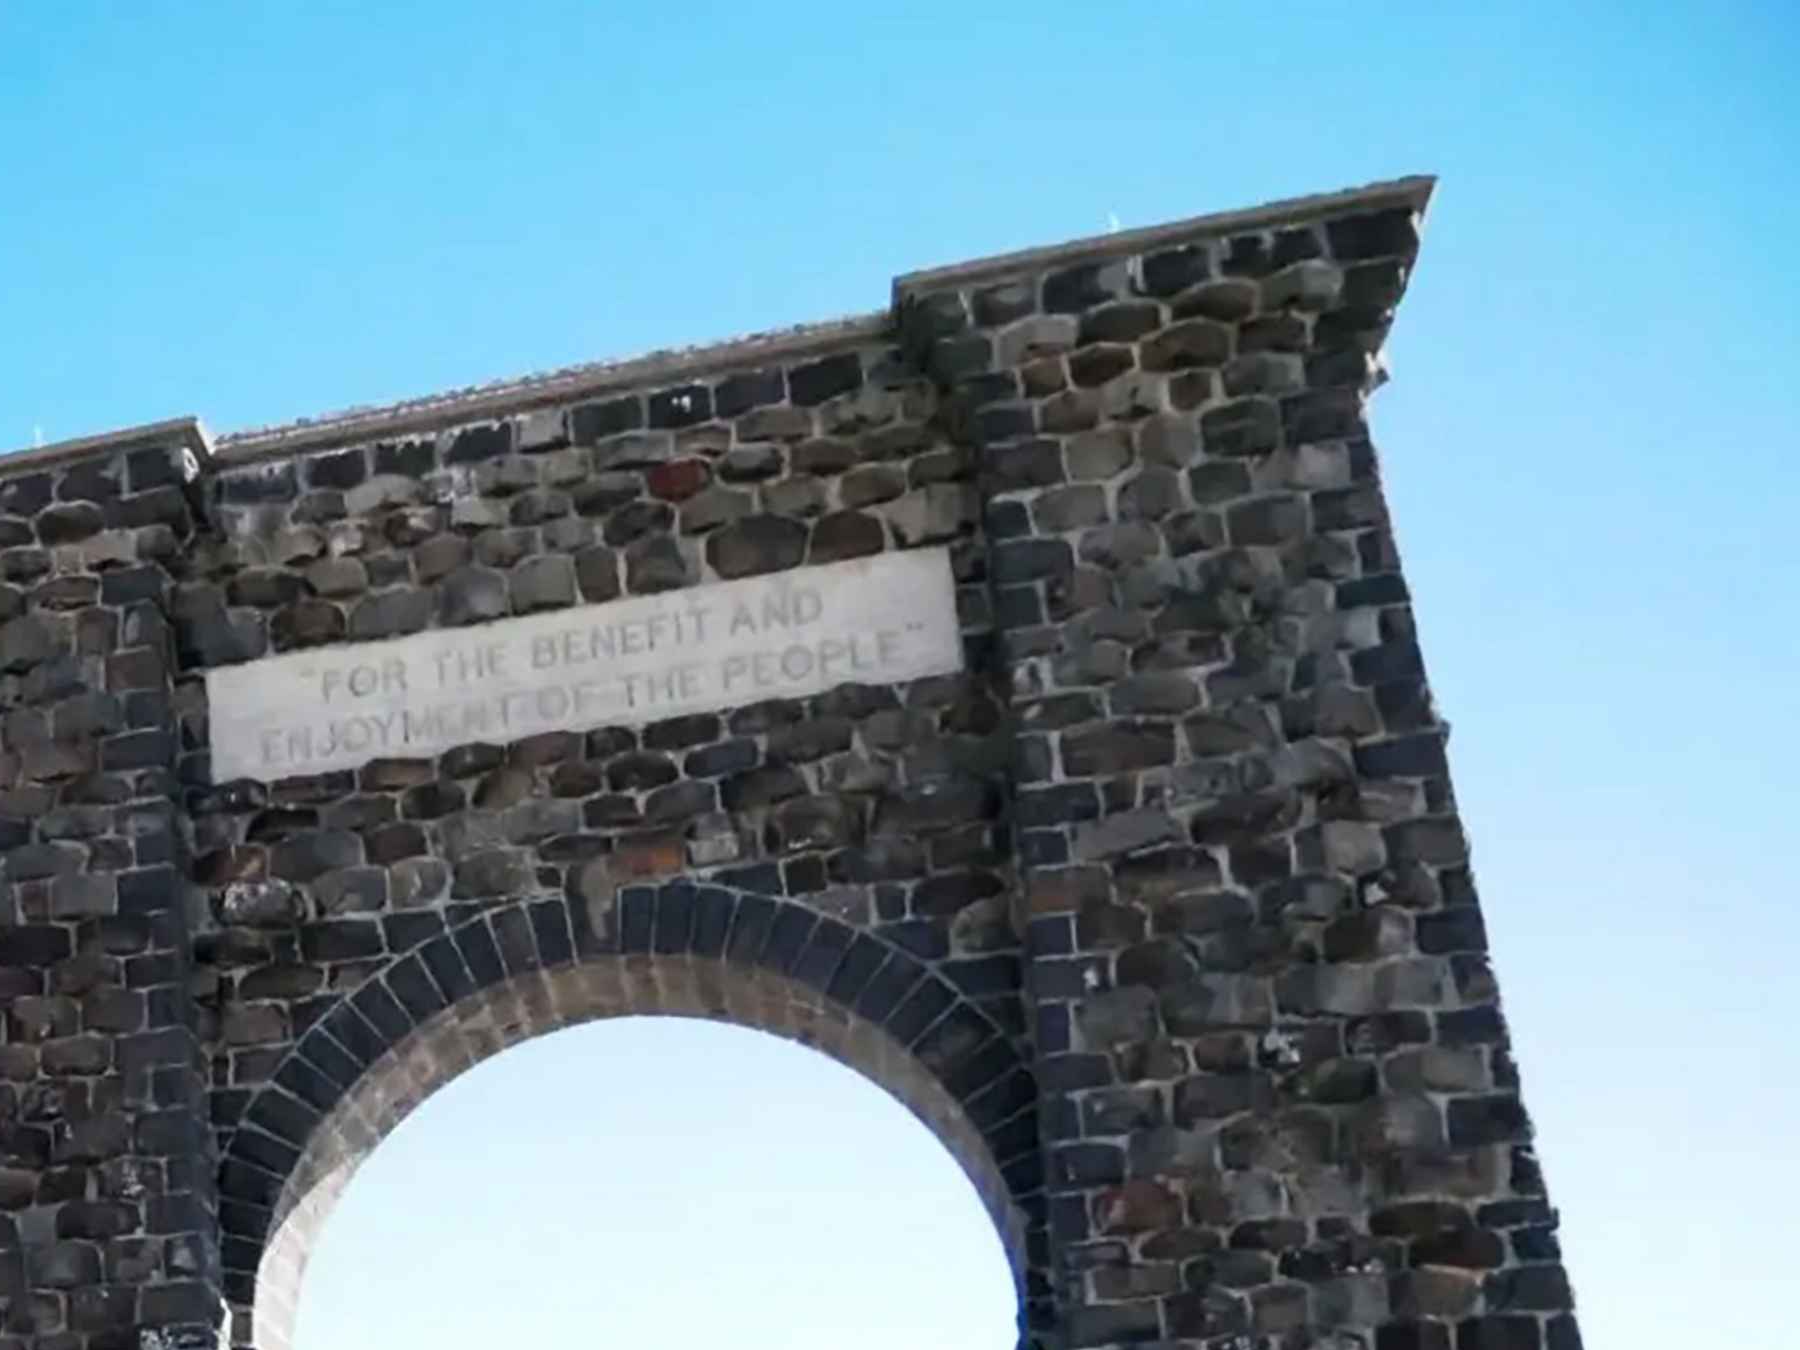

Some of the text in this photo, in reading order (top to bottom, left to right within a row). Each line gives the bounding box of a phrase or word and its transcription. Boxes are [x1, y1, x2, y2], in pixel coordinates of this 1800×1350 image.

[431, 641, 509, 683] THE
[529, 607, 711, 670] BENEFIT
[728, 587, 824, 637] AND
[258, 694, 519, 766] ENJOYMENT
[536, 679, 598, 722] OF
[620, 664, 706, 708] THE
